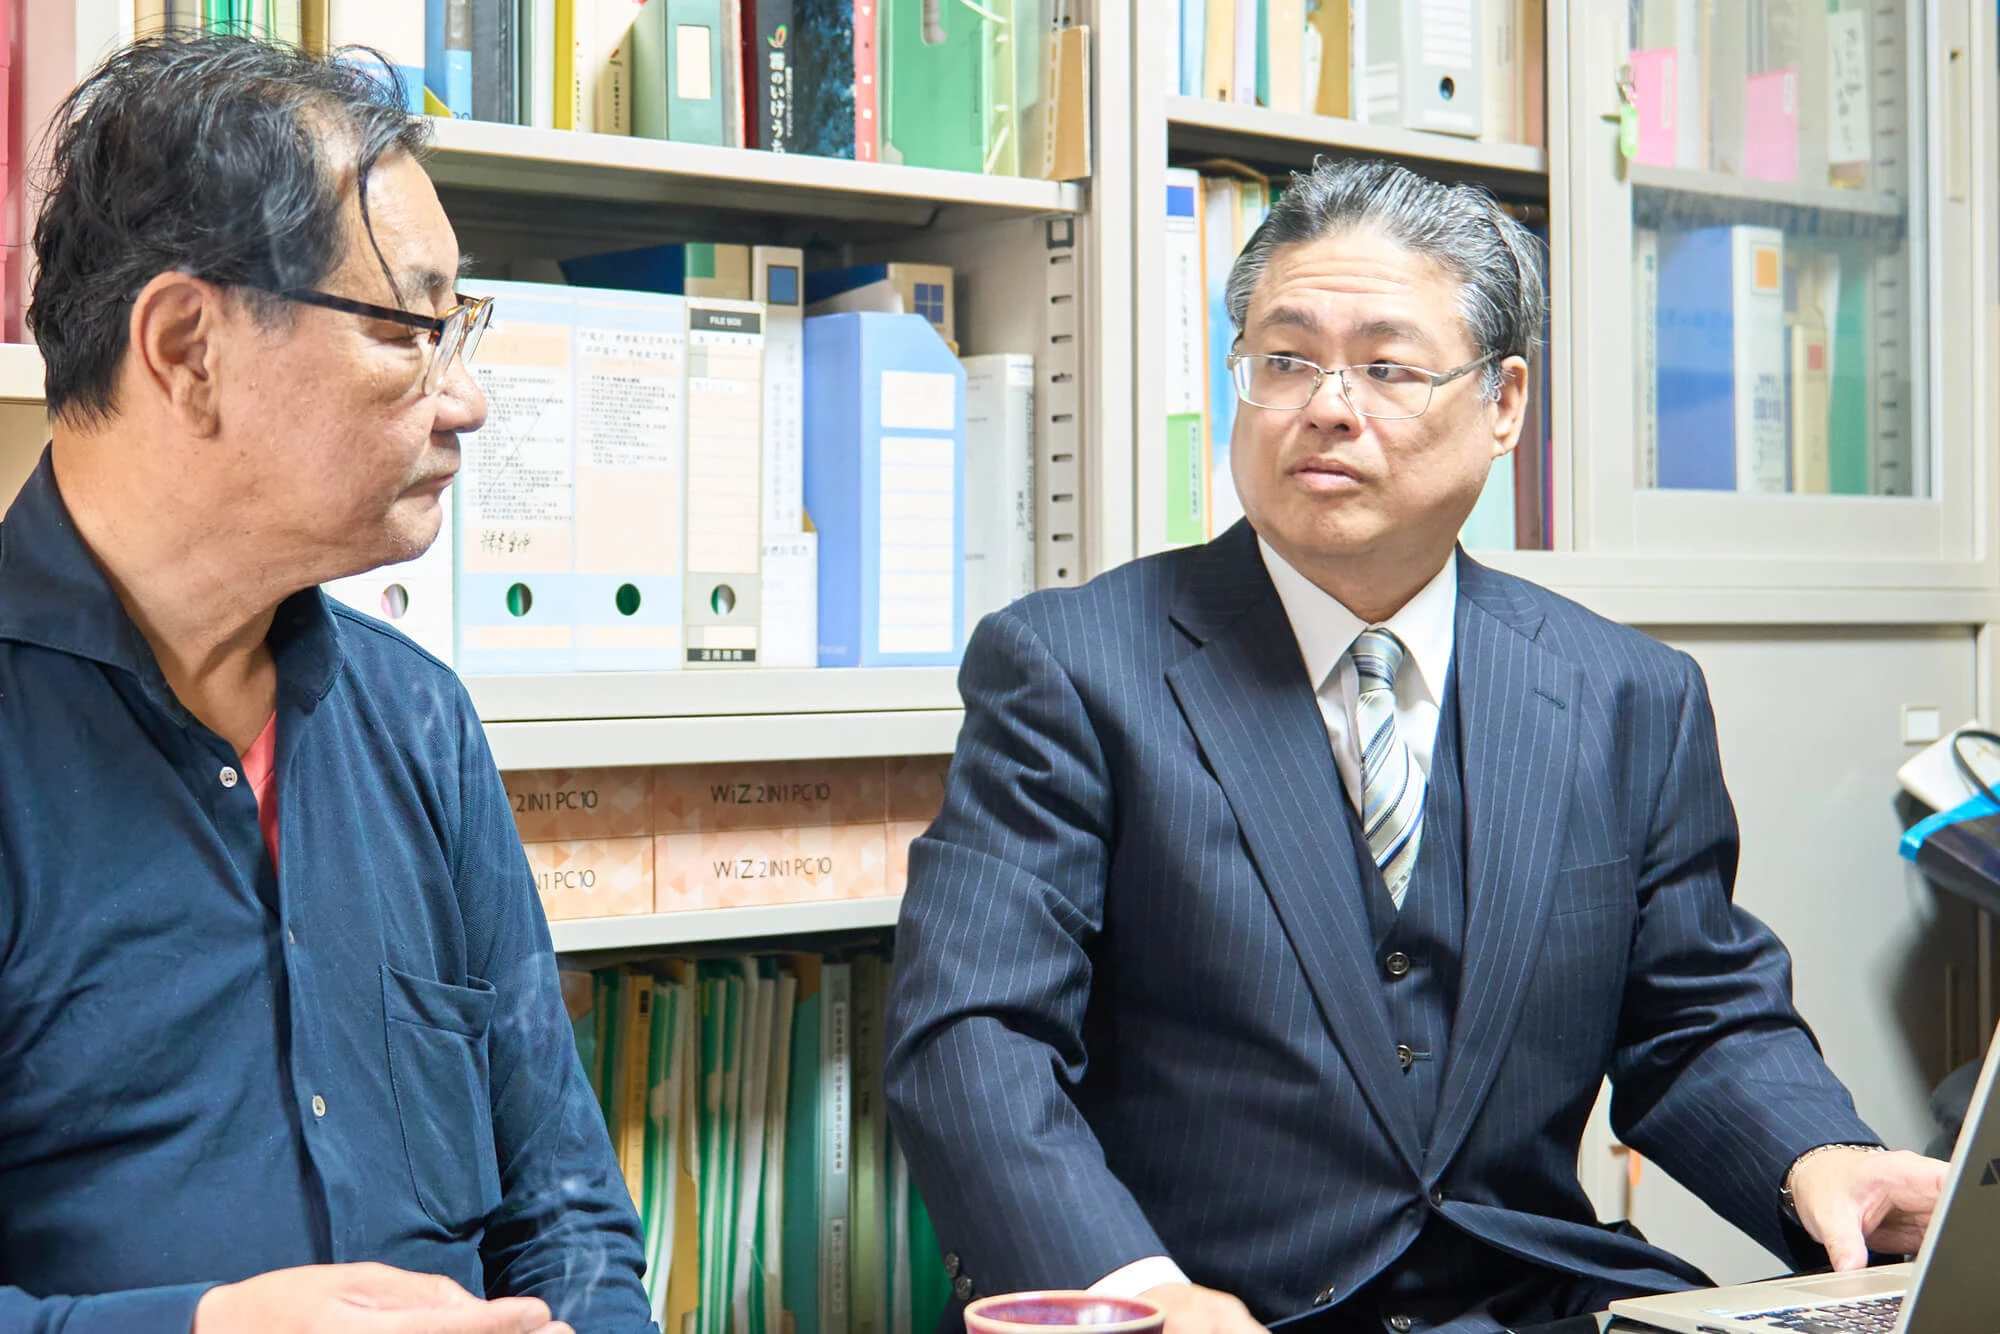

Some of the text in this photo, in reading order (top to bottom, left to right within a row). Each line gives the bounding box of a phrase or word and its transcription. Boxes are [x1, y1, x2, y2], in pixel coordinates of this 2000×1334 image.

[556, 790, 598, 809] PC10
[710, 783, 831, 804] WiZ 2IN1 PC10
[713, 856, 832, 879] WiZ 2IN1 PC10
[554, 869, 596, 889] PC10
